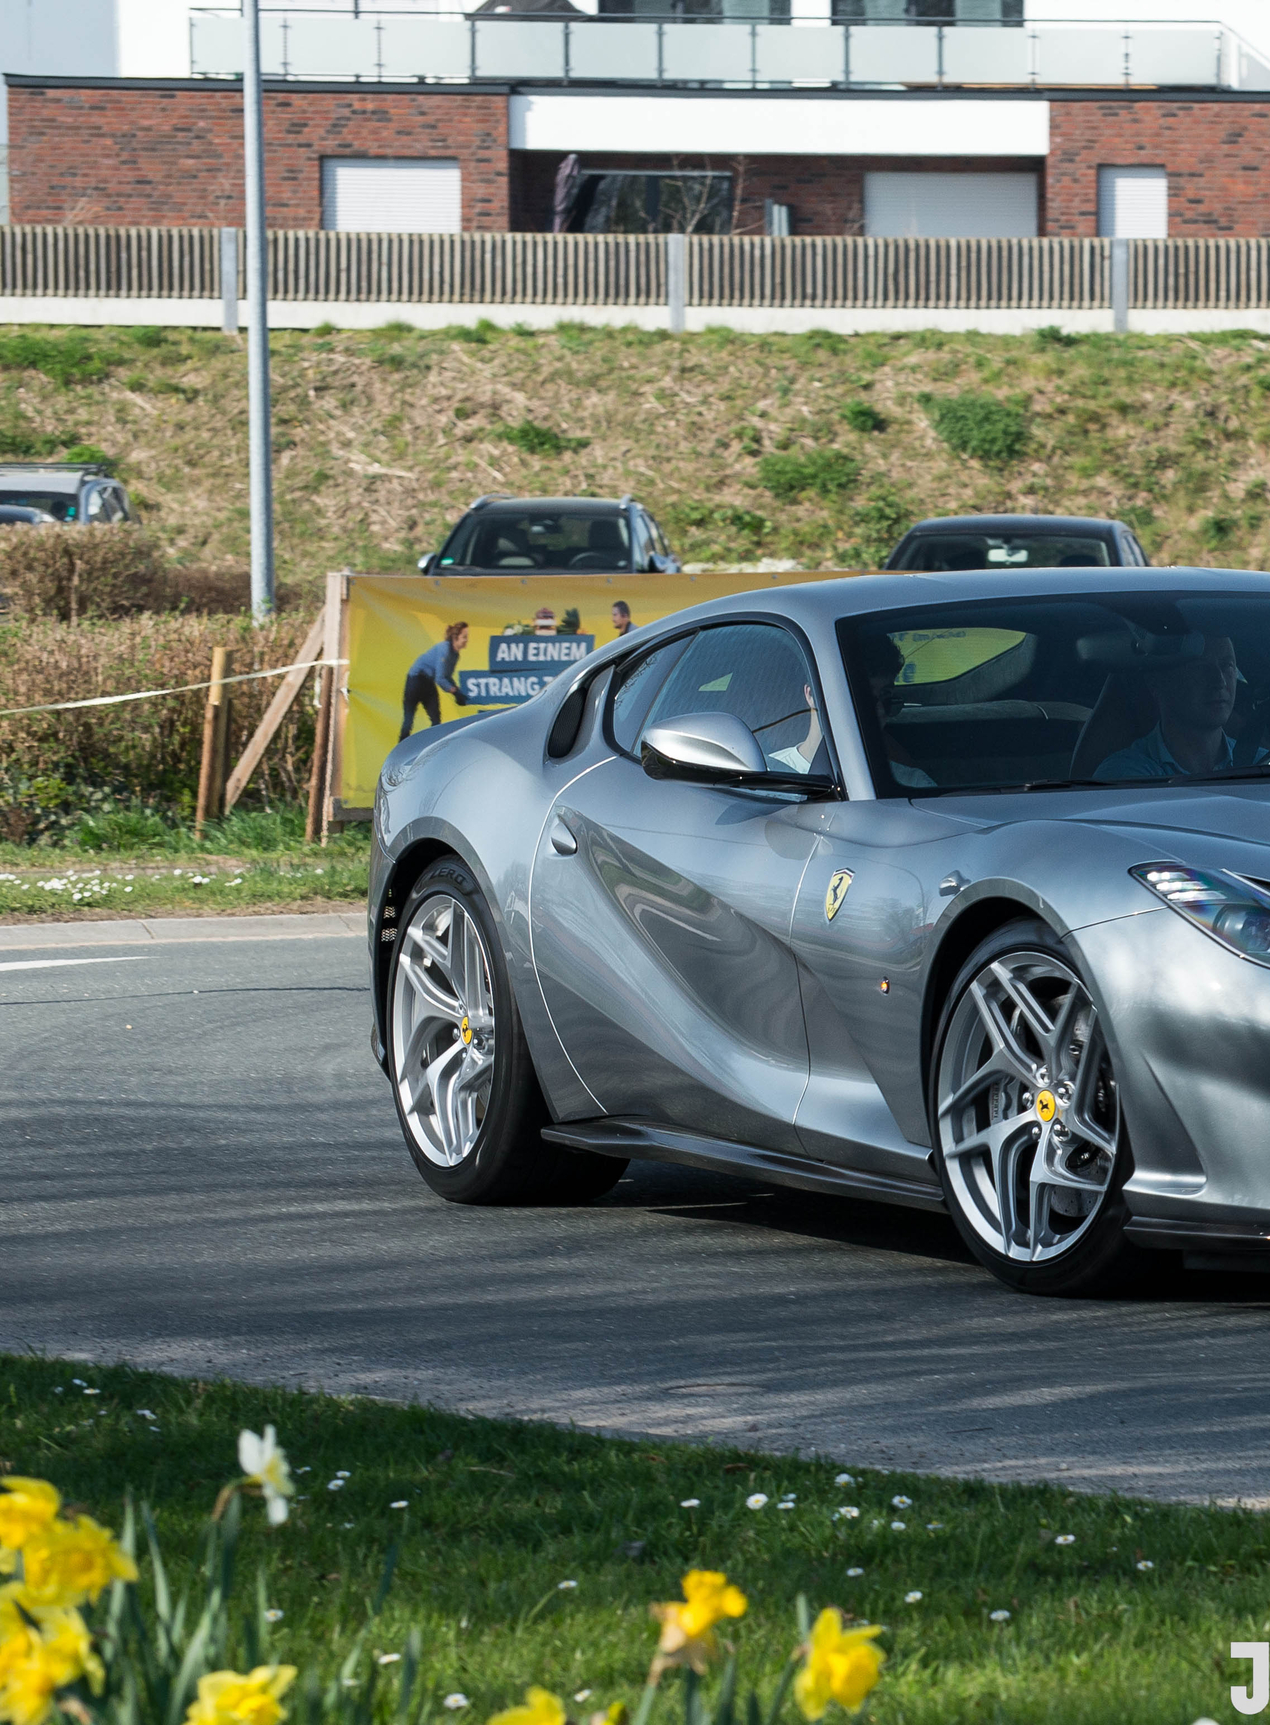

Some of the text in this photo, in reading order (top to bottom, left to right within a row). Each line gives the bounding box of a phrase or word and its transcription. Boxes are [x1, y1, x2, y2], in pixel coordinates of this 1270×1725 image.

[496, 642, 587, 661] AN EINEM
[466, 676, 540, 697] STRANG
